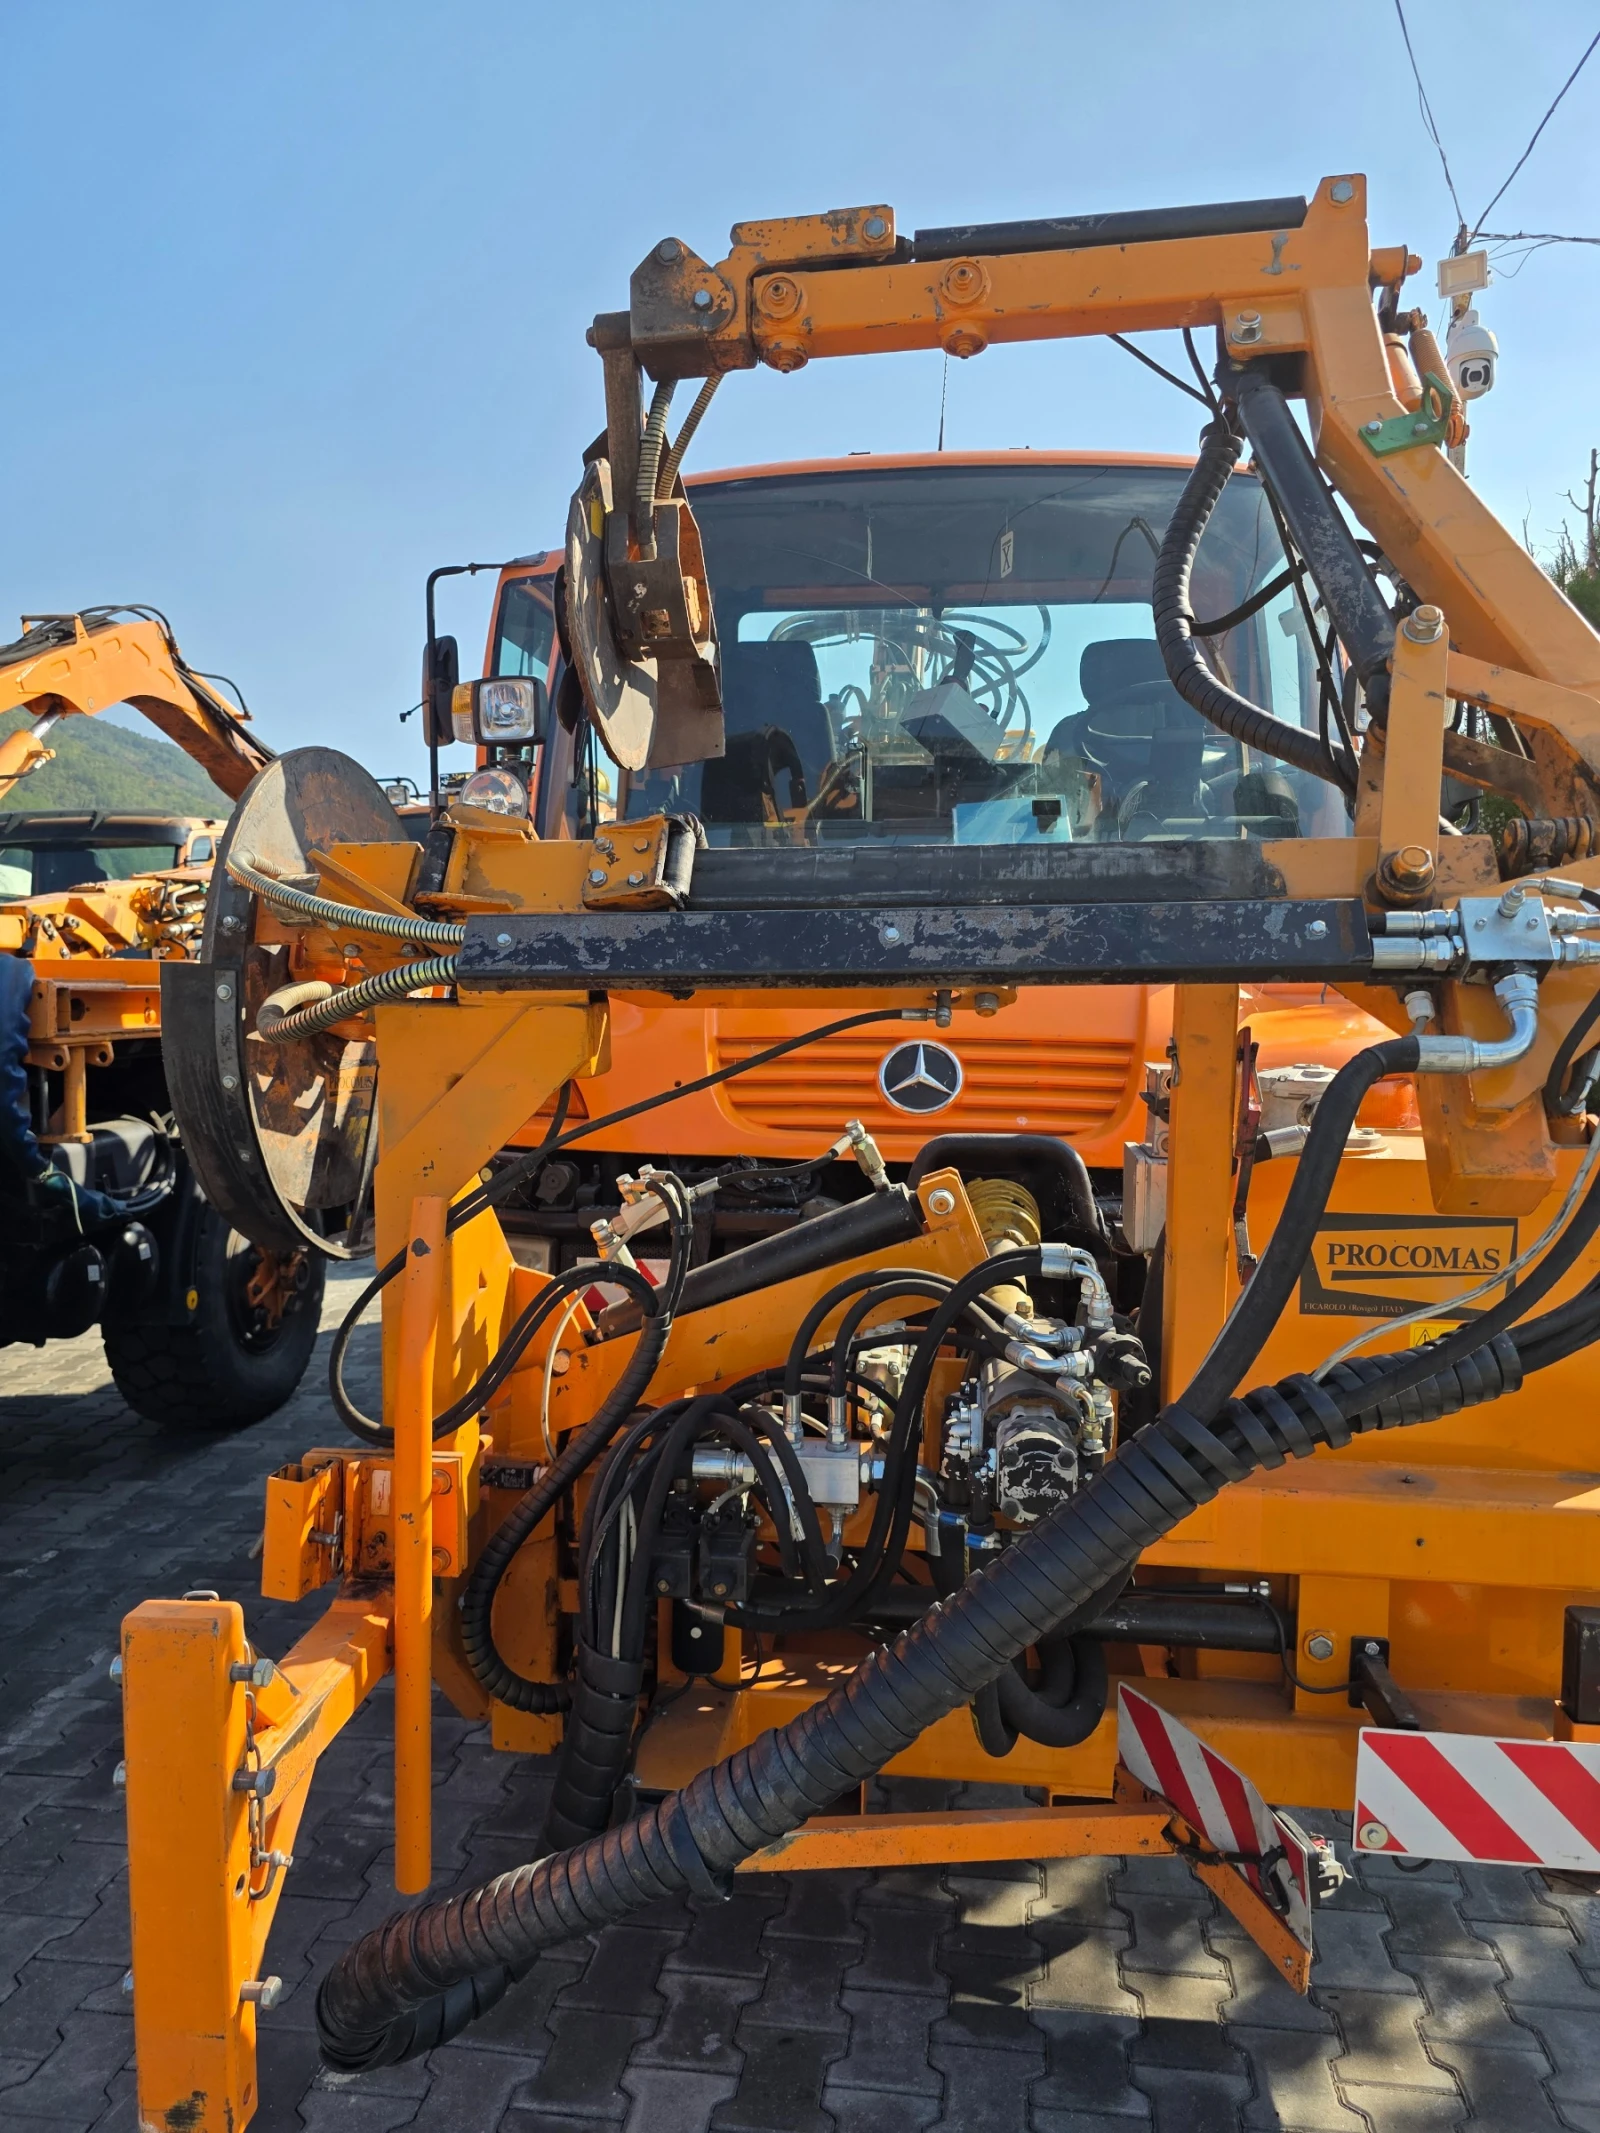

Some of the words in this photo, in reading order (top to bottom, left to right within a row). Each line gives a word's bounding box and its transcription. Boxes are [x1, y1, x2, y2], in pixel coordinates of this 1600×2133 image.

[1326, 1243, 1500, 1270] PROCOMAS
[1304, 1303, 1346, 1311] FICAROLO
[1348, 1305, 1378, 1313] (Rovigo)
[1381, 1305, 1405, 1313] ITALY
